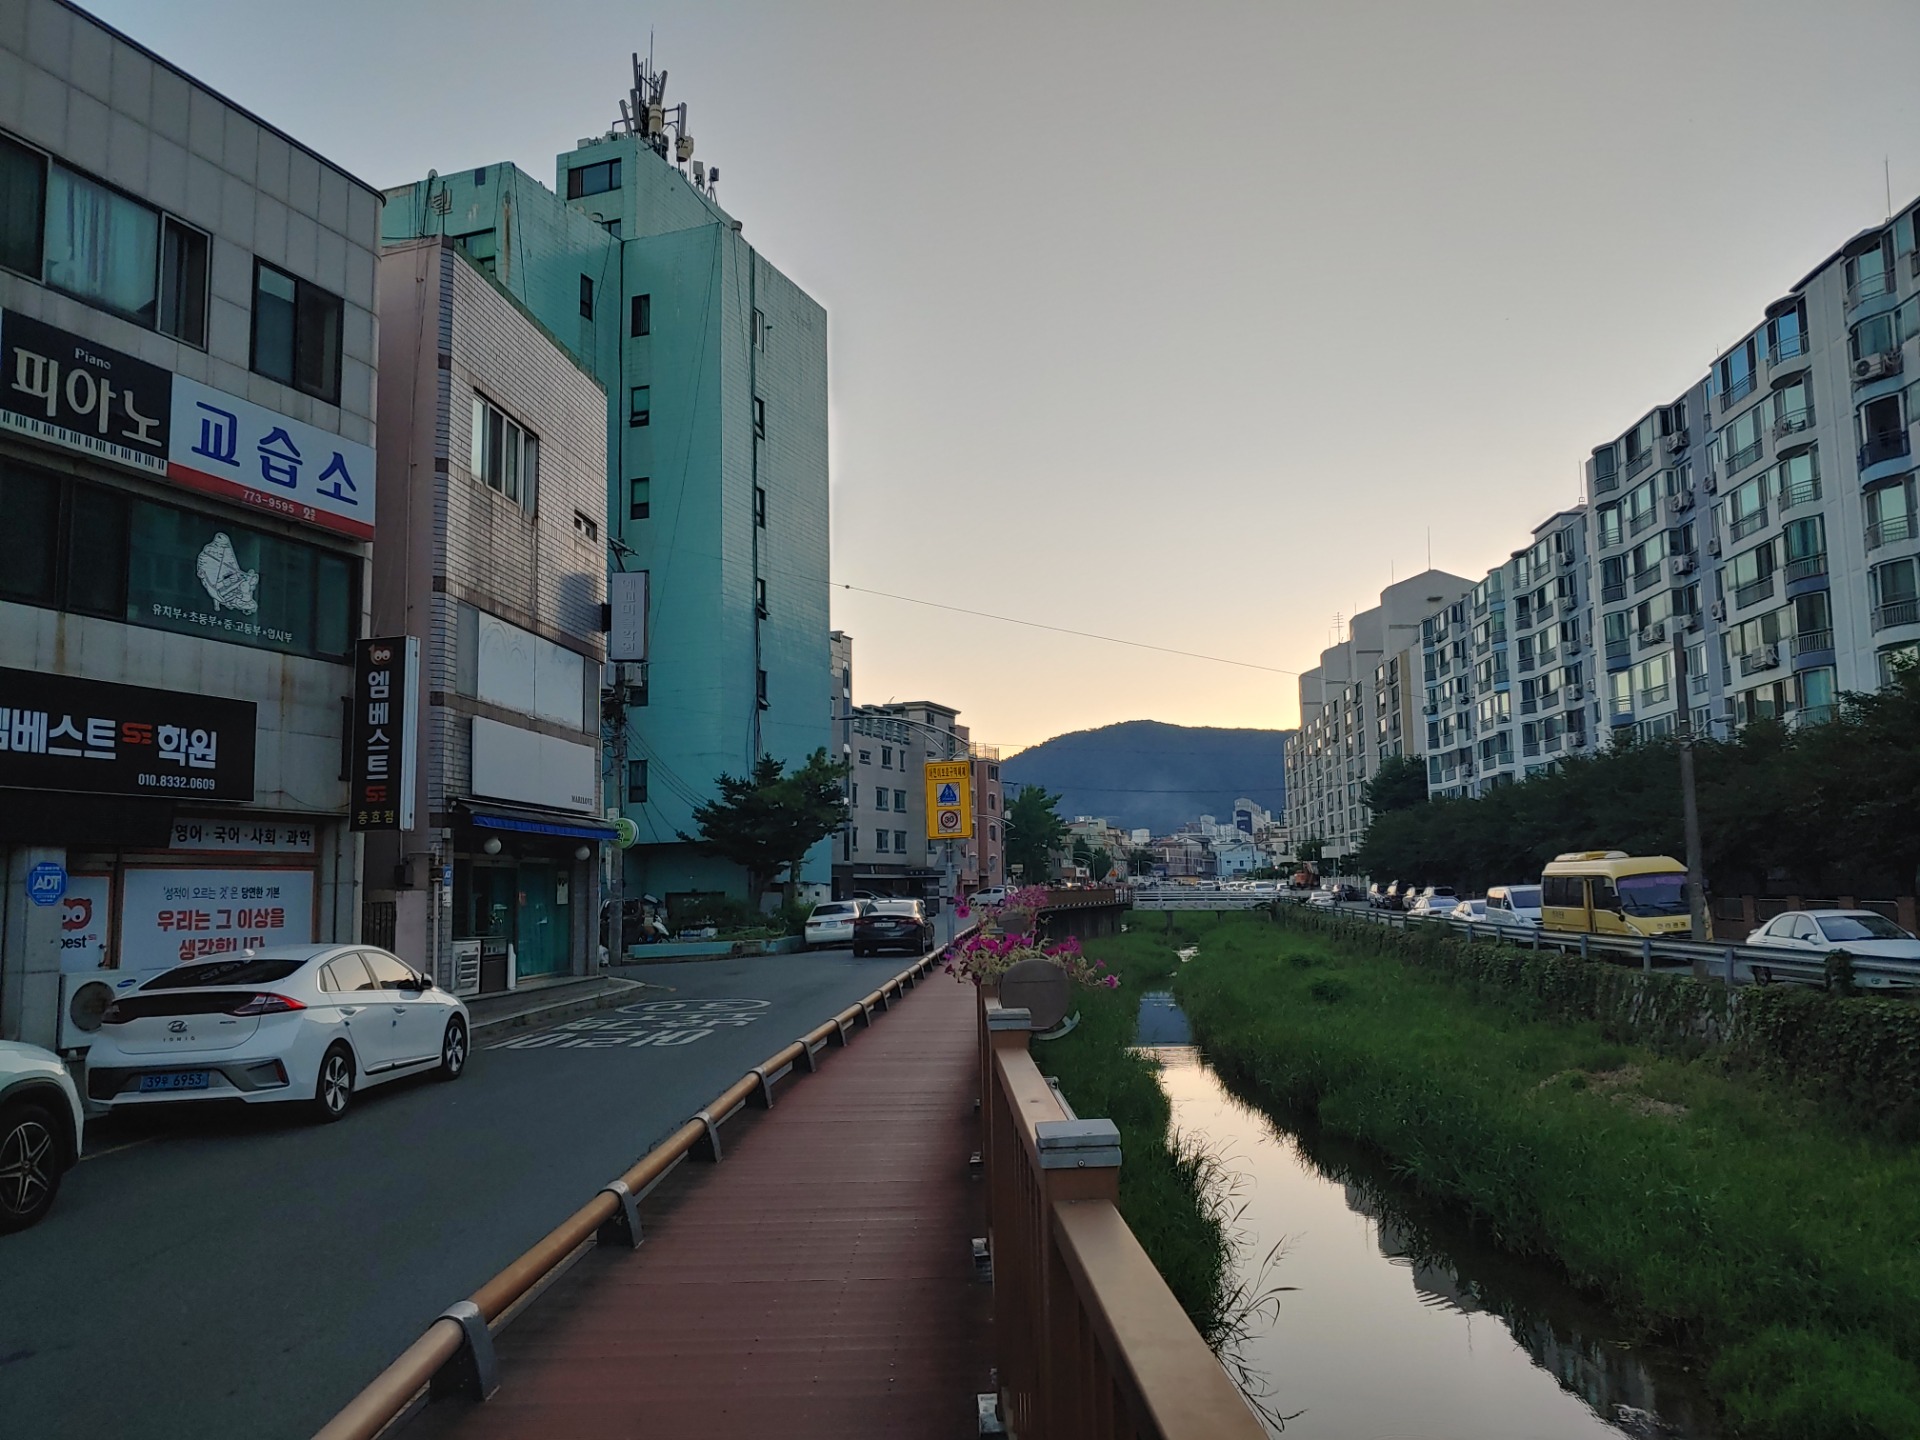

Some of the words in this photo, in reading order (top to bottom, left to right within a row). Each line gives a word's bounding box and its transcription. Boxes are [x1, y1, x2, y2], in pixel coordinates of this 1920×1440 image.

[74, 346, 112, 370] Piano
[10, 345, 164, 448] 피아노
[191, 400, 359, 506] 교습소
[243, 490, 295, 513] 773-9595
[366, 669, 391, 781] 엠베스트
[157, 723, 218, 769] 학원
[138, 773, 216, 790] 010.8332.0609
[357, 809, 395, 826] 충효점
[175, 824, 203, 843] 영어
[213, 826, 240, 844] 국어
[250, 827, 276, 845] 사회
[286, 829, 312, 846] 과학
[33, 874, 61, 890] ADT
[192, 887, 216, 900] 오르는
[241, 886, 263, 900] 당연한
[266, 886, 280, 899] 기본
[157, 909, 210, 932] 우리는
[216, 909, 232, 930] 그
[237, 907, 285, 929] 이상을
[173, 1074, 203, 1087] 6953
